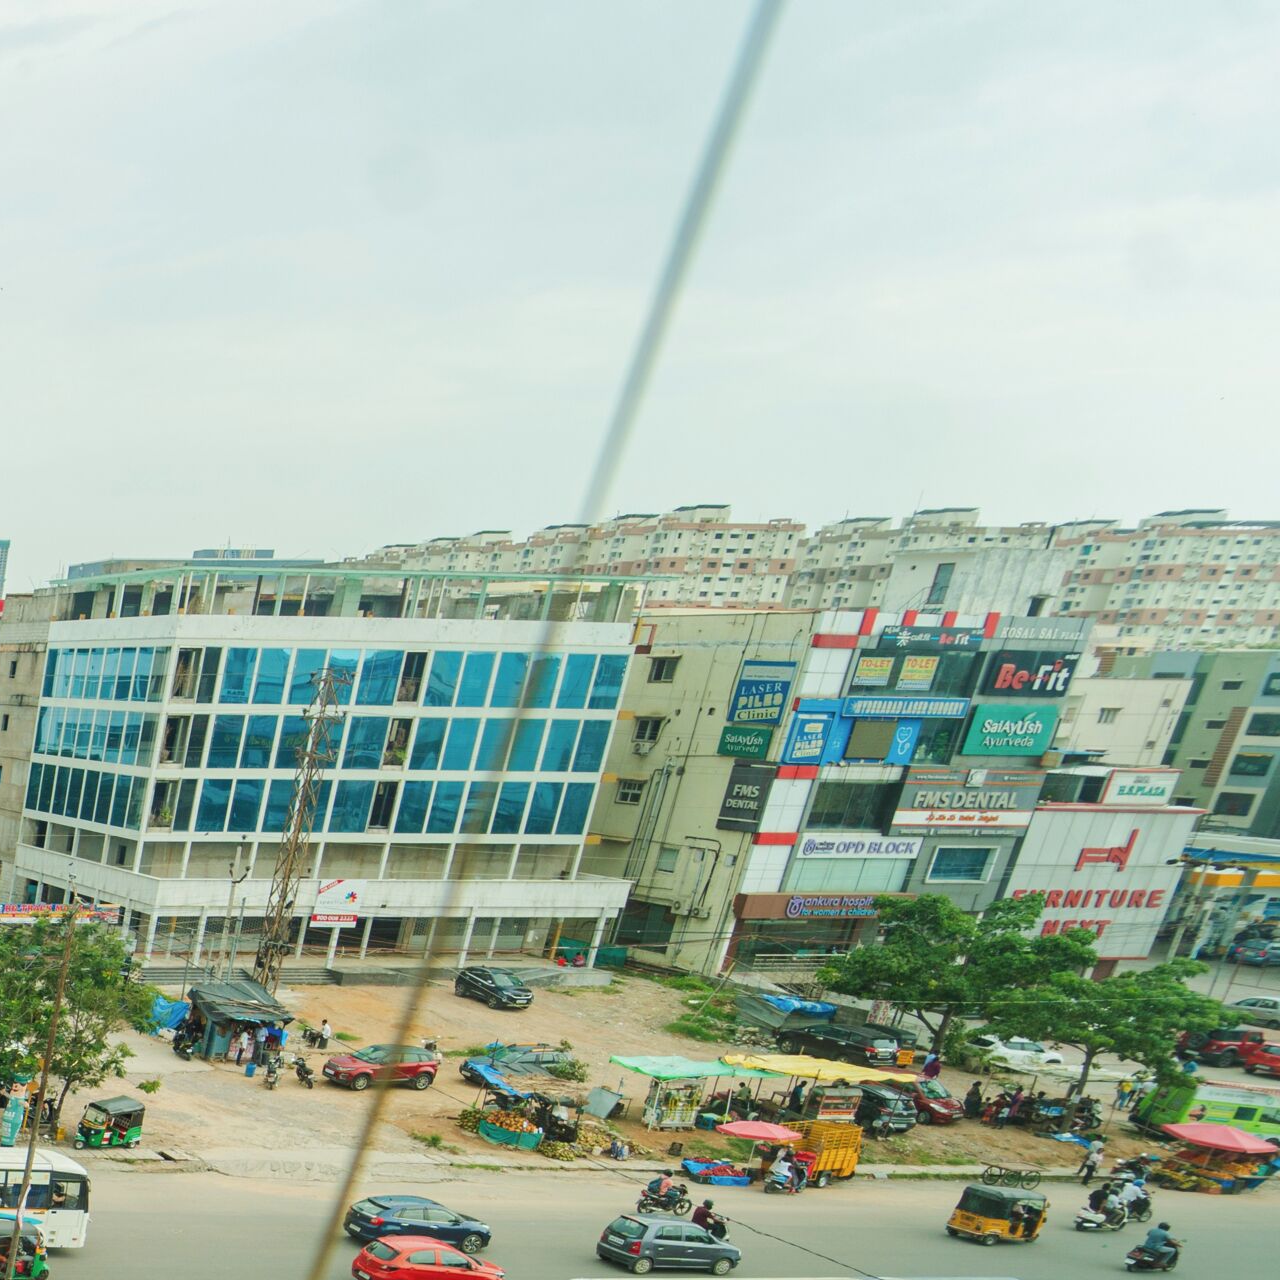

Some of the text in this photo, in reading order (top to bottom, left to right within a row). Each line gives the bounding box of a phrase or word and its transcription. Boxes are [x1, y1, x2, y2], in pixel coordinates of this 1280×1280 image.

[1000, 628, 1036, 639] KOSAL
[1040, 628, 1059, 639] SAI
[860, 659, 892, 668] TO-LET
[906, 658, 935, 668] TO-LET
[741, 682, 782, 695] LASER
[737, 709, 776, 720] Clinic
[983, 736, 1034, 748] Ayurveda
[732, 784, 760, 798] FMS
[726, 799, 758, 810] DENTAL
[912, 790, 1018, 808] FMS DENTAL
[836, 841, 916, 854] OPD BLOCK
[805, 896, 840, 906] ankura
[1013, 890, 1166, 908] FRNITURE
